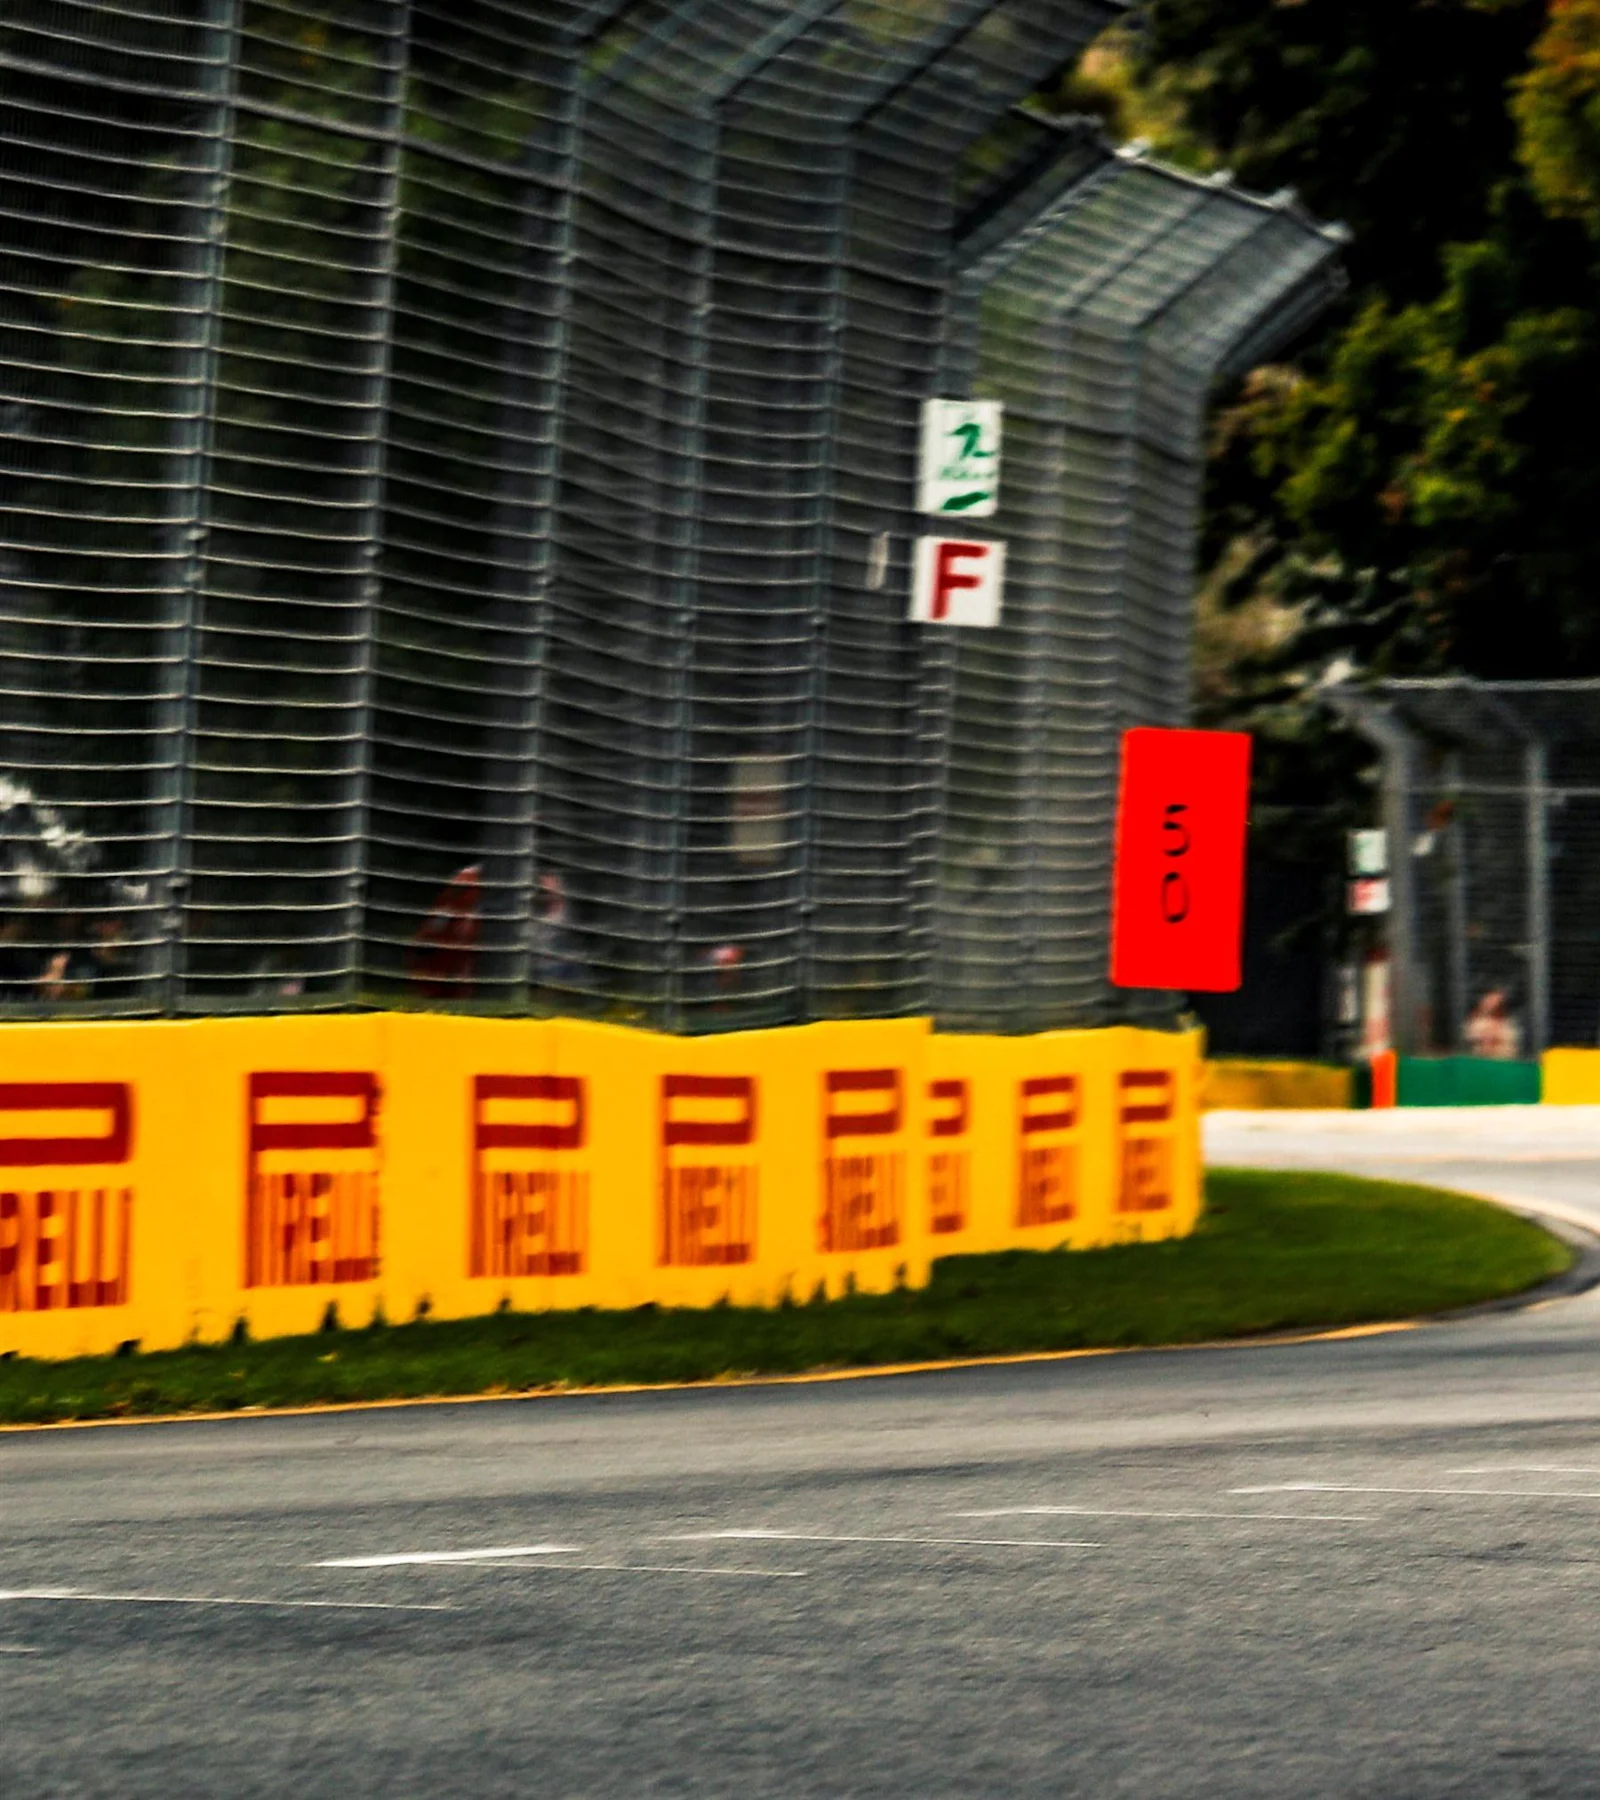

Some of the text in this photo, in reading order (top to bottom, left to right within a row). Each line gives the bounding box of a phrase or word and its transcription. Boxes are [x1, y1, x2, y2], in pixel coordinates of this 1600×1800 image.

[931, 543, 988, 620] F
[1162, 803, 1191, 924] 50
[242, 1071, 383, 1288] PIRELLI
